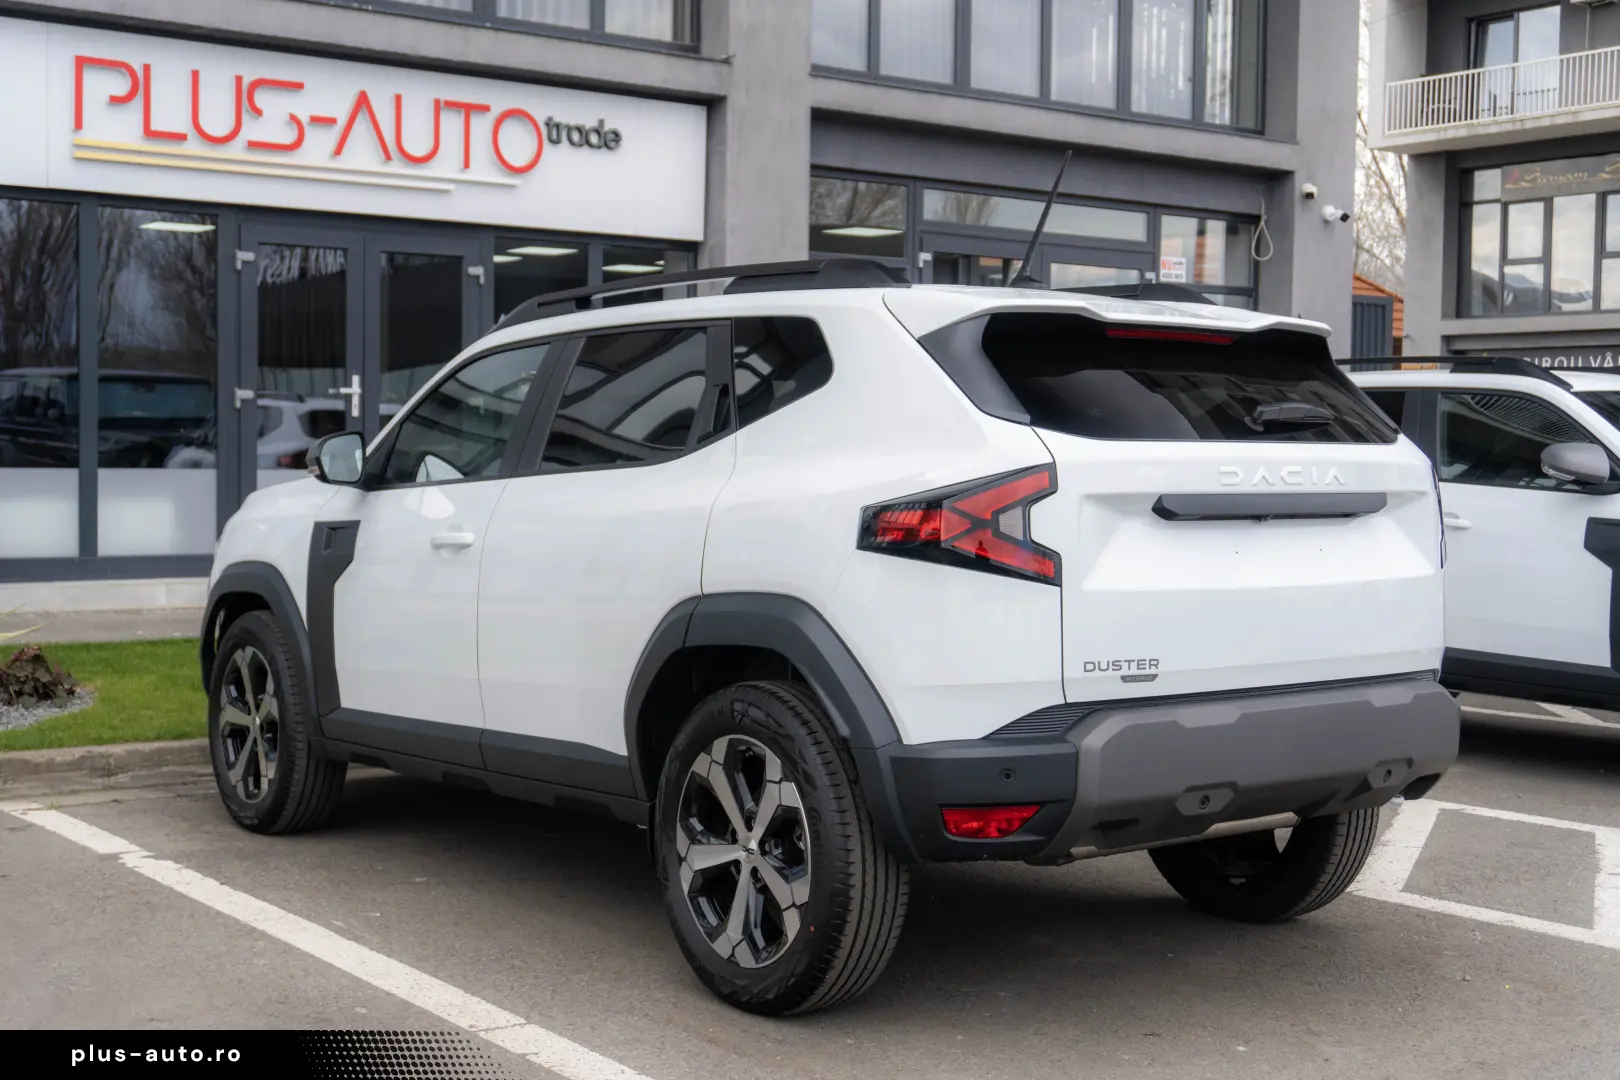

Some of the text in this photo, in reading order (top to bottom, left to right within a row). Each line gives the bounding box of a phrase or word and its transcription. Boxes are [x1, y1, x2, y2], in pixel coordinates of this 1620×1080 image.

[74, 55, 622, 174] PLUS-AUTO trade
[1522, 351, 1620, 368] IROU VÂ
[1218, 465, 1346, 487] DACIA
[1083, 658, 1160, 673] DUSTER
